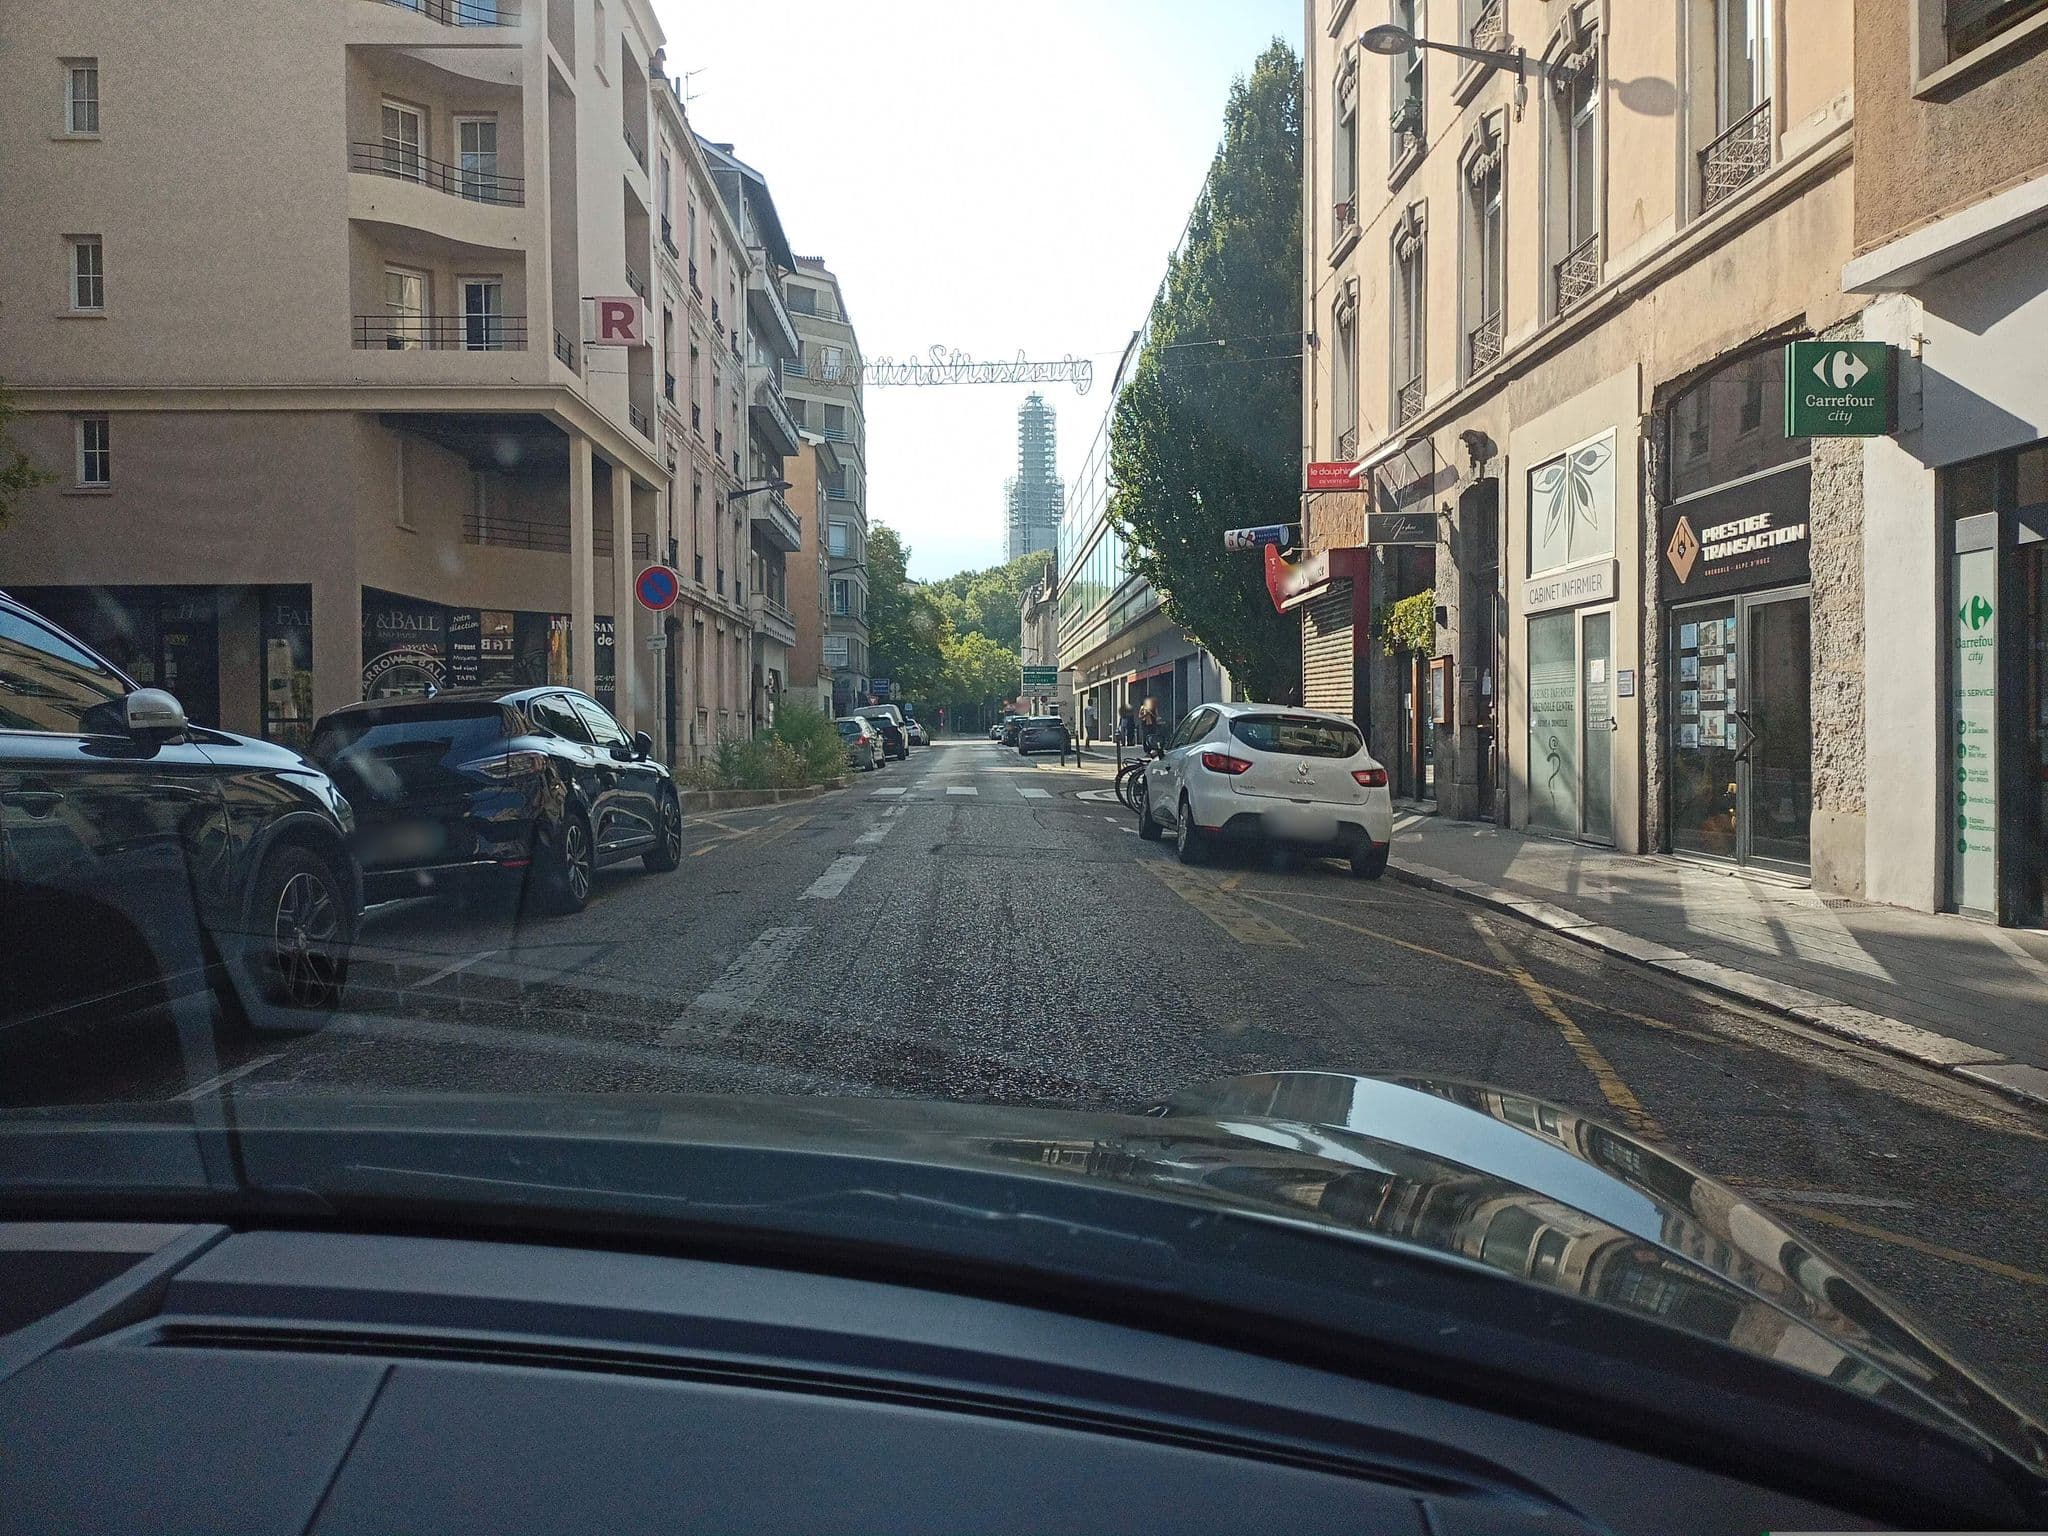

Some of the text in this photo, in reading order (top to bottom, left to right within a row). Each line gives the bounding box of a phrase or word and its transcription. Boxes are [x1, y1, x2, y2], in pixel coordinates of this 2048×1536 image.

[601, 302, 635, 338] R
[928, 344, 1093, 396] Strasbourg
[1805, 394, 1875, 407] Carrefour
[1828, 410, 1853, 426] city
[1310, 467, 1351, 477] le dauphin
[1702, 512, 1773, 543] PRESTIGE
[1701, 523, 1807, 561] TRANSACTION
[1529, 573, 1603, 605] CABINET INFIRMIER
[597, 633, 614, 646] de
[1956, 636, 1993, 648] Carrefou
[1968, 651, 1984, 664] city
[361, 654, 402, 690] ARROW
[1967, 688, 1995, 697] SERVICE
